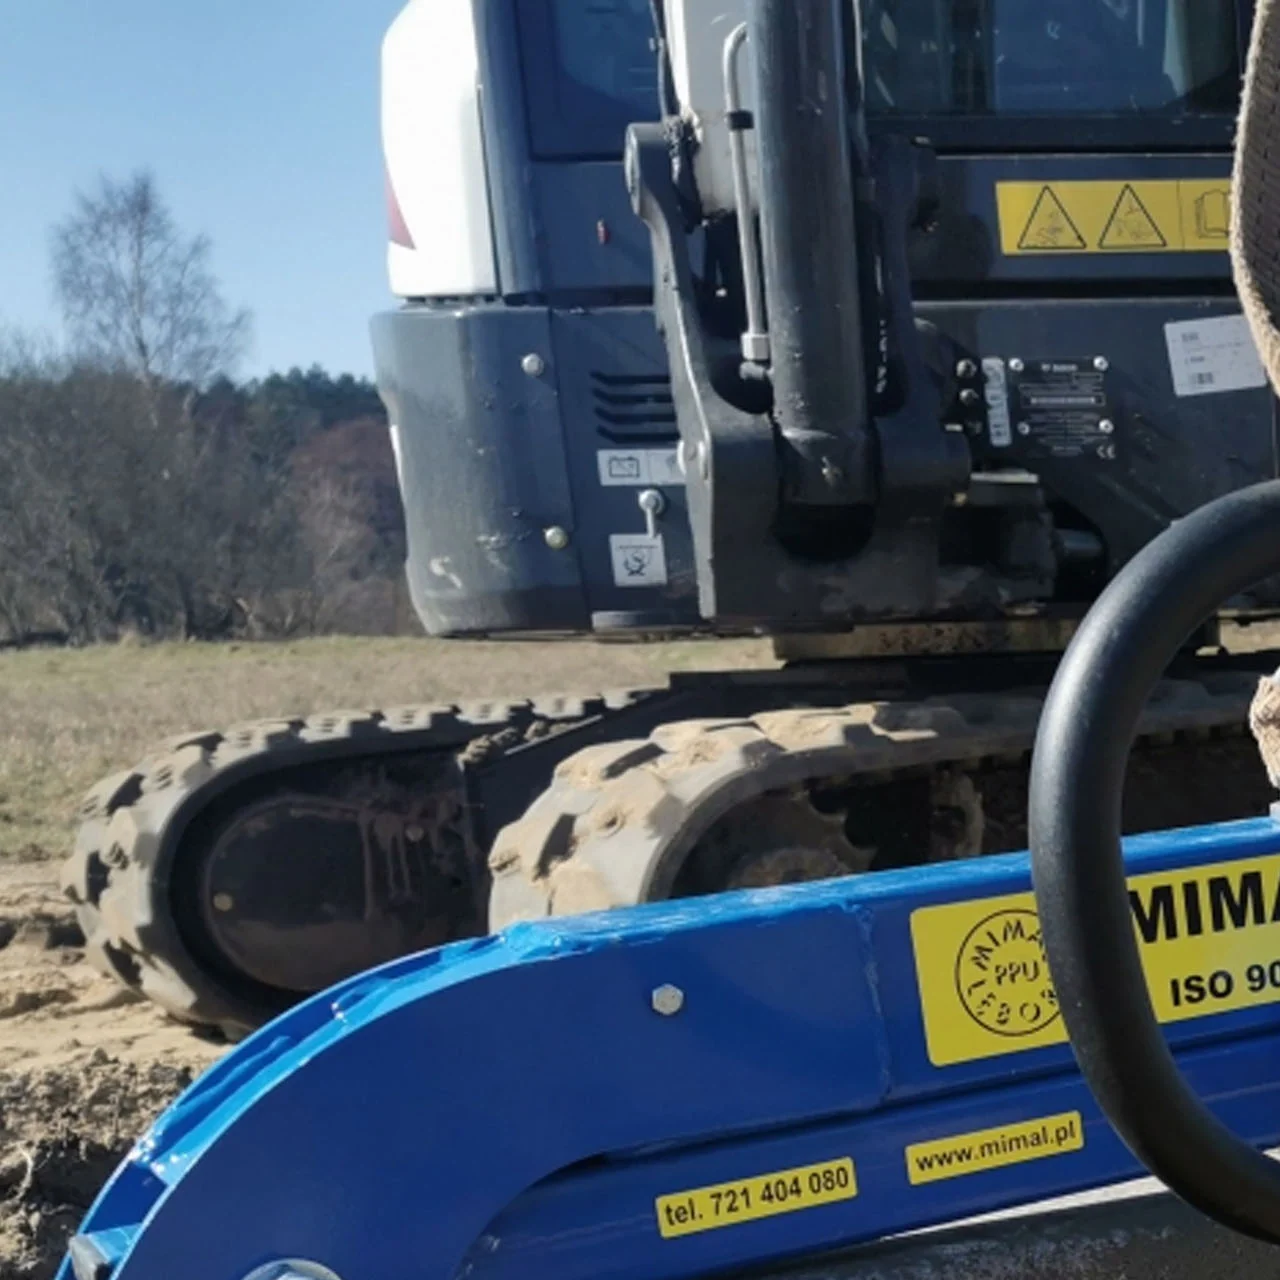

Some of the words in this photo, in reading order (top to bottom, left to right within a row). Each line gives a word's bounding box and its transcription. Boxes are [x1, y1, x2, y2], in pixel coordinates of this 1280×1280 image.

[970, 919, 1047, 971] MIMA
[995, 960, 1040, 986] PPU
[1170, 970, 1234, 1007] ISO
[915, 1119, 1076, 1171] www.mimal.pl
[665, 1198, 703, 1226] tel.
[709, 1187, 751, 1216] 721
[760, 1176, 802, 1204] 404
[808, 1166, 849, 1194] 080
